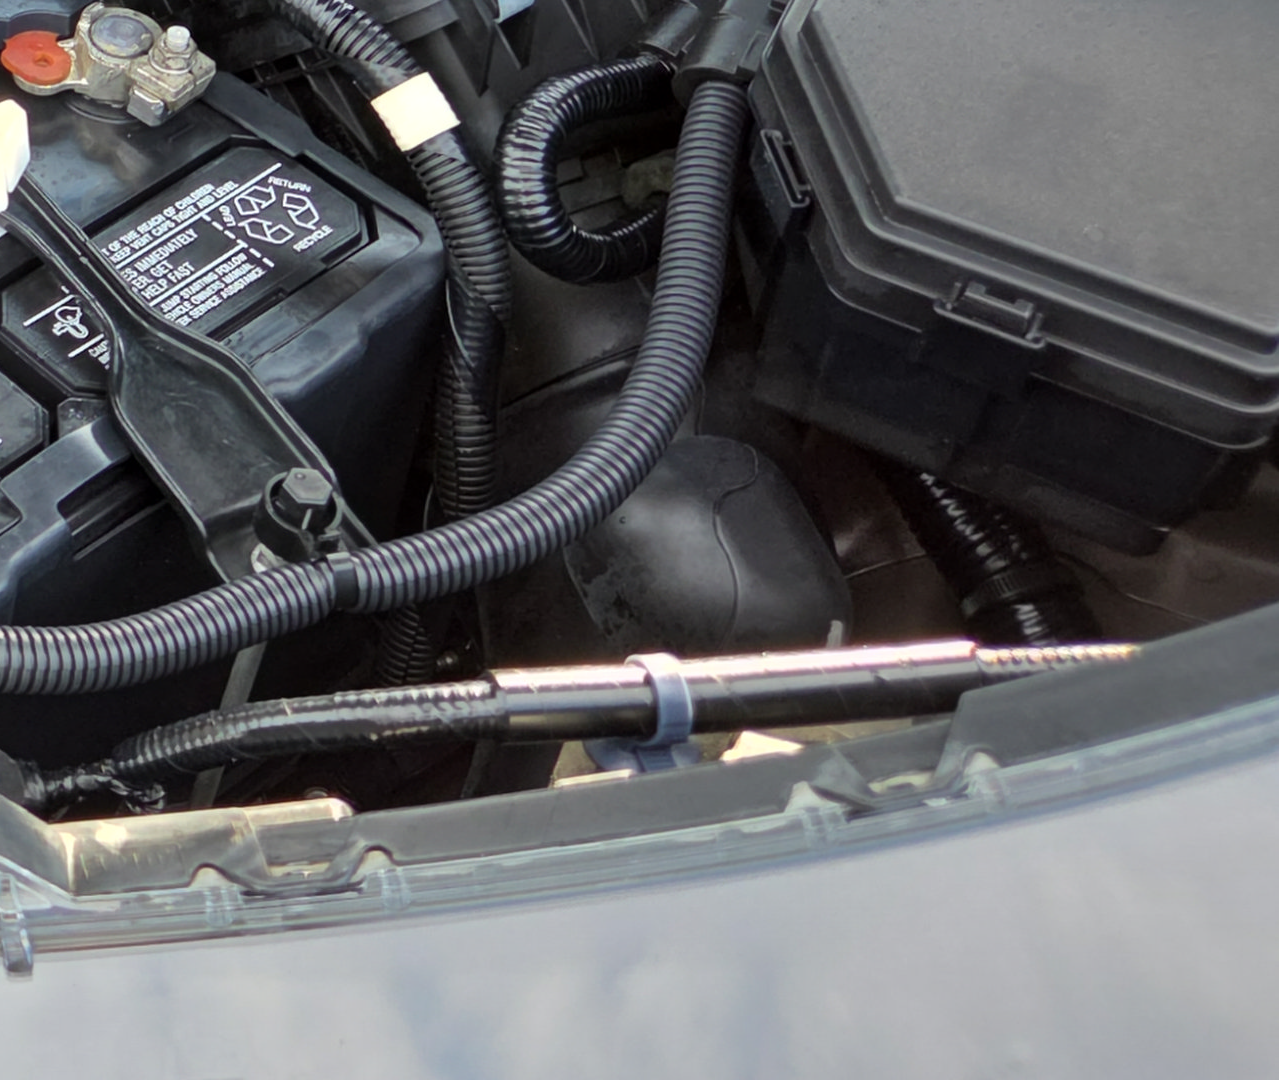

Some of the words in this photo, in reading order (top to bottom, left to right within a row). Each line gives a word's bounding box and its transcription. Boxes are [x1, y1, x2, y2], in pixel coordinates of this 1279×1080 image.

[267, 175, 312, 193] RETURN
[106, 239, 124, 252] OF
[118, 229, 140, 244] THE
[134, 212, 167, 234] REACH
[161, 205, 179, 217] OF
[173, 182, 216, 210] CHILDREN
[107, 245, 134, 263] KEEP
[128, 232, 154, 250] VENT
[149, 219, 177, 237] CAPS
[171, 204, 199, 224] TIGHT
[194, 193, 217, 209] AND
[211, 179, 240, 199] LEVEL
[218, 205, 236, 227] LEAD
[132, 228, 199, 271] IMMEDIATELY
[293, 224, 334, 252] RECYCLE
[139, 277, 172, 299] HELP
[165, 261, 197, 283] FAST
[147, 259, 175, 278] GET
[177, 271, 219, 299] STARTING
[213, 252, 249, 275] FOLLOW
[162, 300, 195, 322] EHICLE
[187, 279, 226, 304] OWNERS
[185, 293, 223, 318] SERVICE
[216, 265, 267, 298] ASSISTANCE
